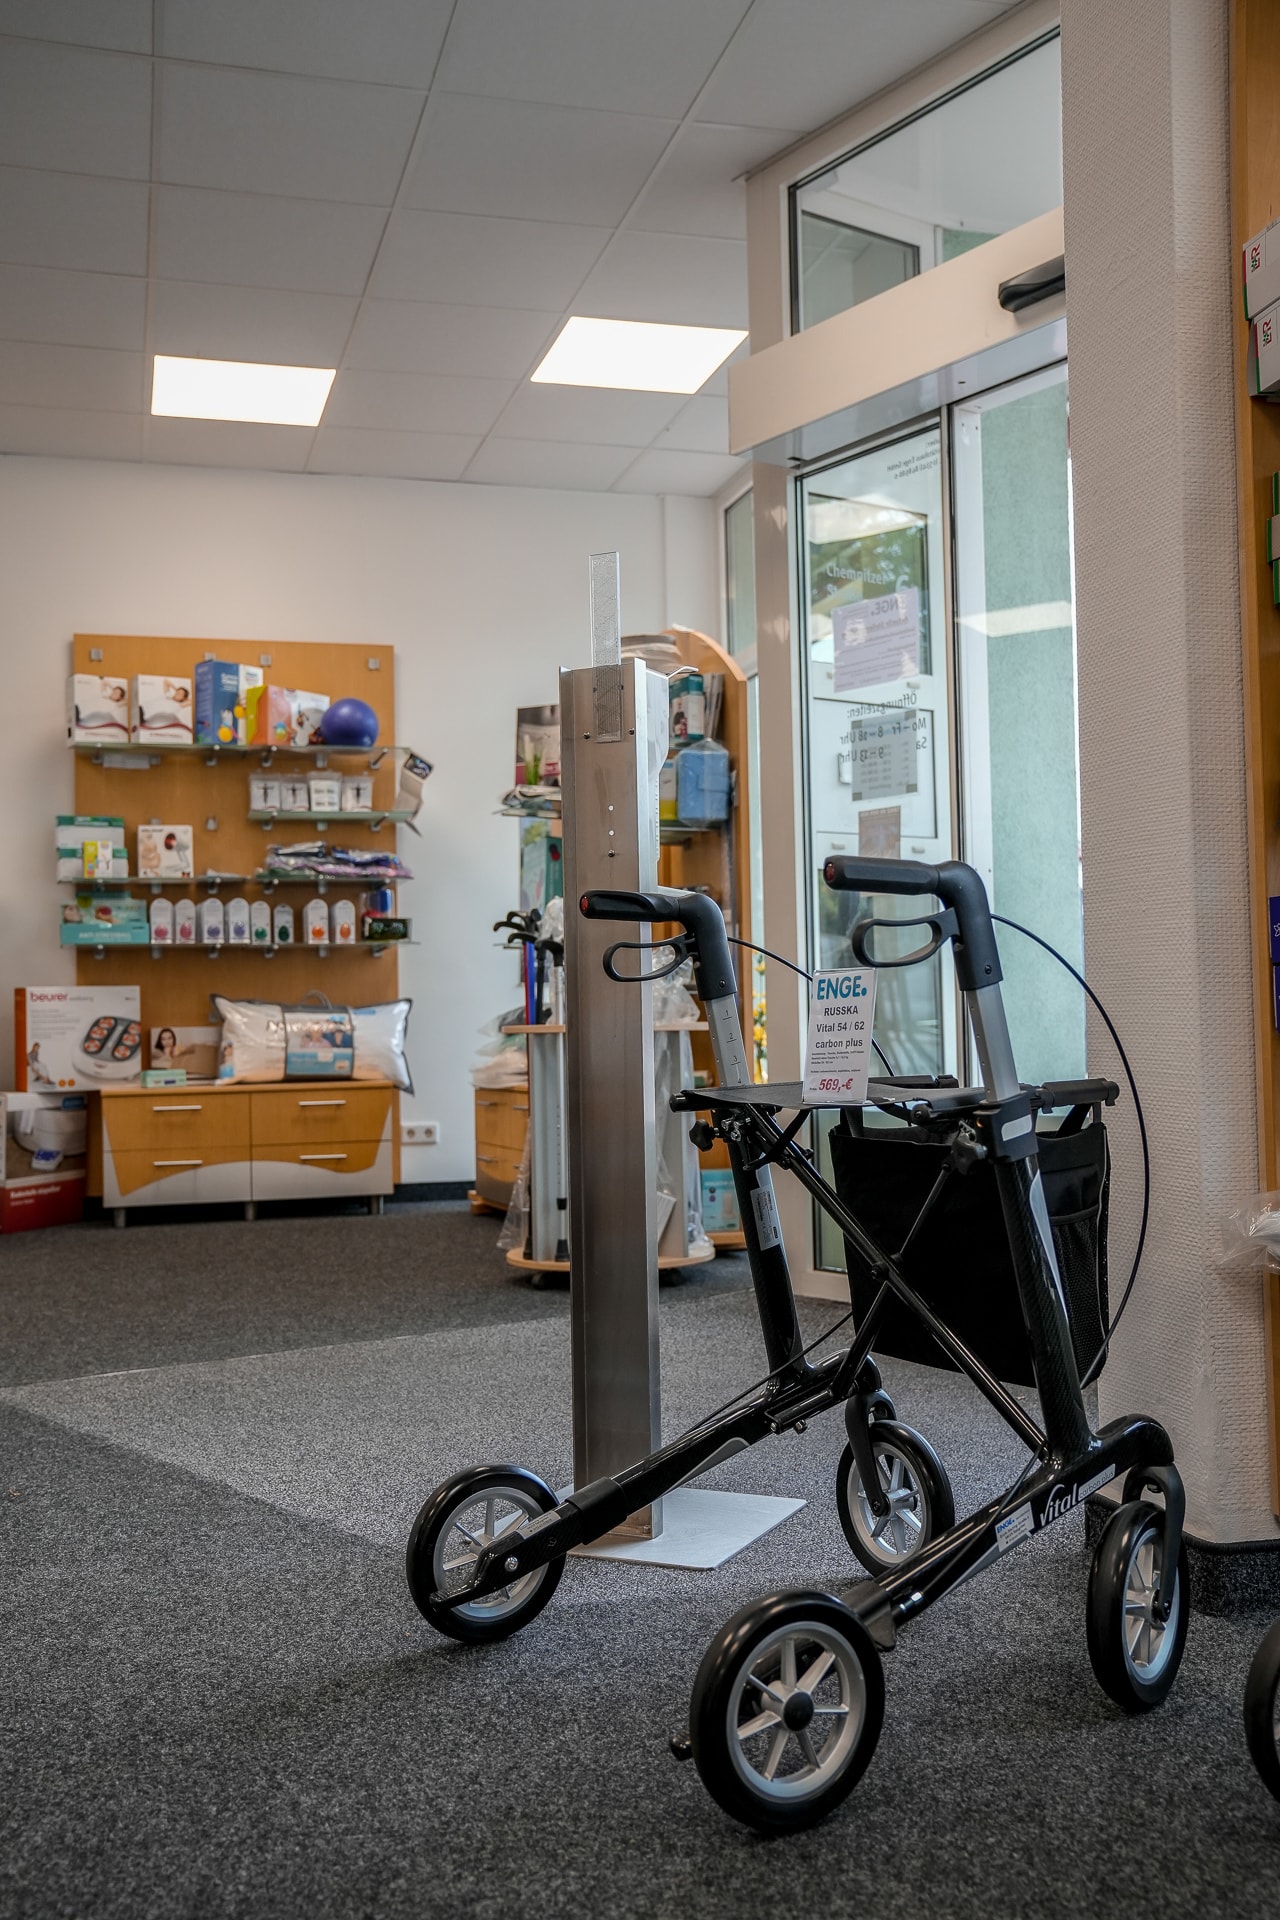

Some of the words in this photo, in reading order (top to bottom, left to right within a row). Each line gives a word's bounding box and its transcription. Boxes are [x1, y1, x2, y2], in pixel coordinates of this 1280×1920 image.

[817, 976, 867, 1000] ENGE.
[30, 992, 68, 1003] beurer
[824, 1005, 858, 1016] RUSSKA
[816, 1023, 835, 1033] Vital
[837, 1022, 847, 1032] 54
[854, 1021, 865, 1031] 62
[815, 1039, 843, 1049] carbon
[846, 1038, 863, 1049] plus
[818, 1078, 853, 1093] 569,-€
[1101, 1471, 1114, 1484] plus
